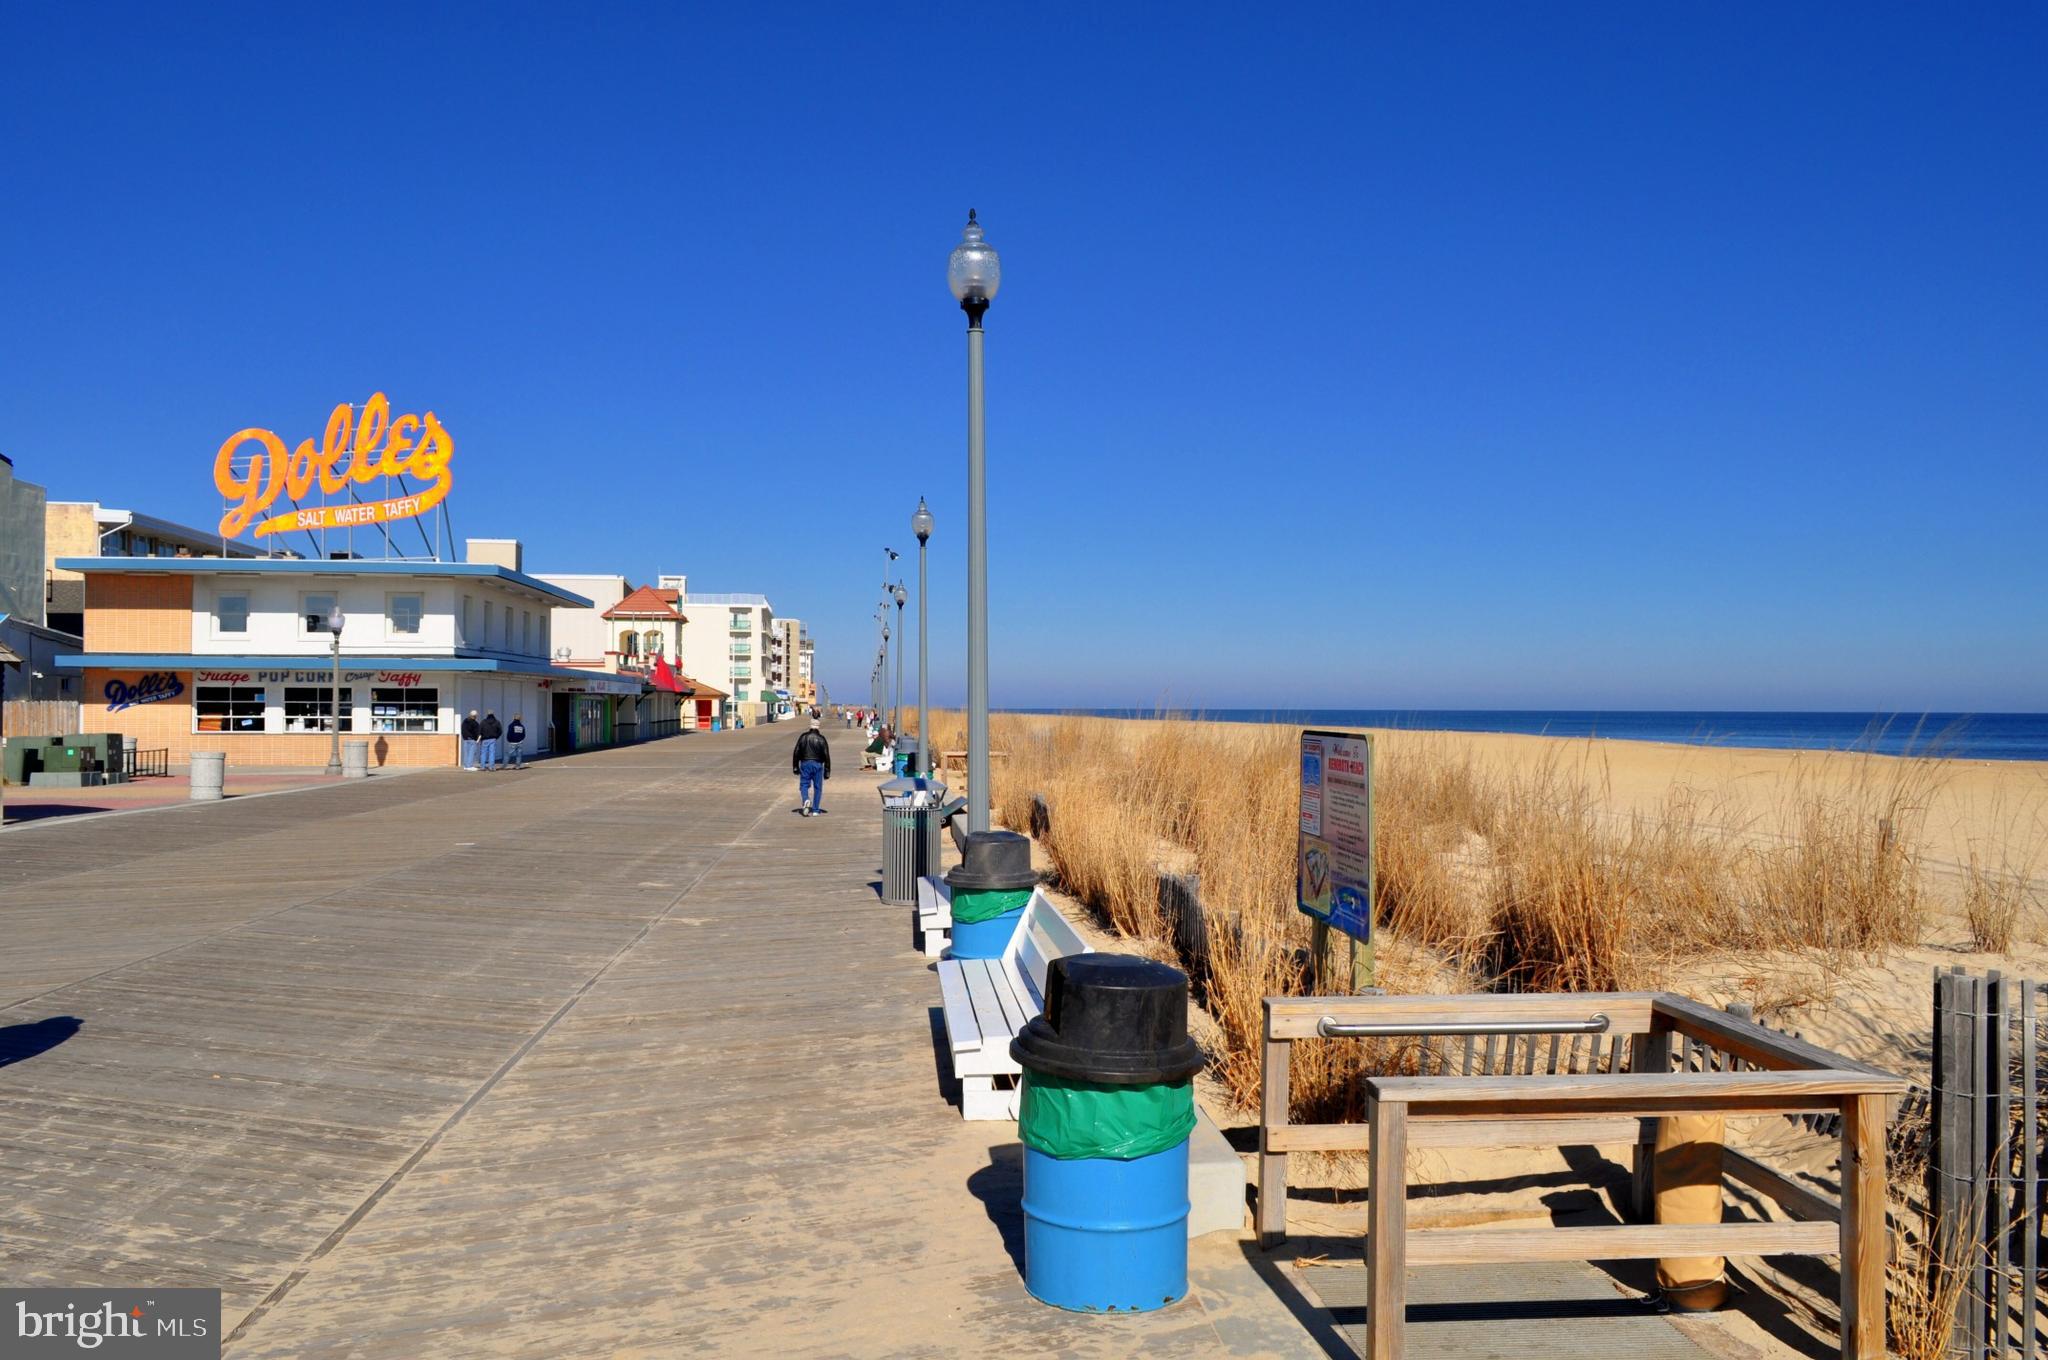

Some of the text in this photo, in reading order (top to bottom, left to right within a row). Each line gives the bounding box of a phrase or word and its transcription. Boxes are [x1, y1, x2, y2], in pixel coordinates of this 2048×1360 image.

[297, 497, 422, 527] SALT WATER TAFFY
[198, 671, 250, 686] Fudge
[378, 670, 422, 687] Taffy
